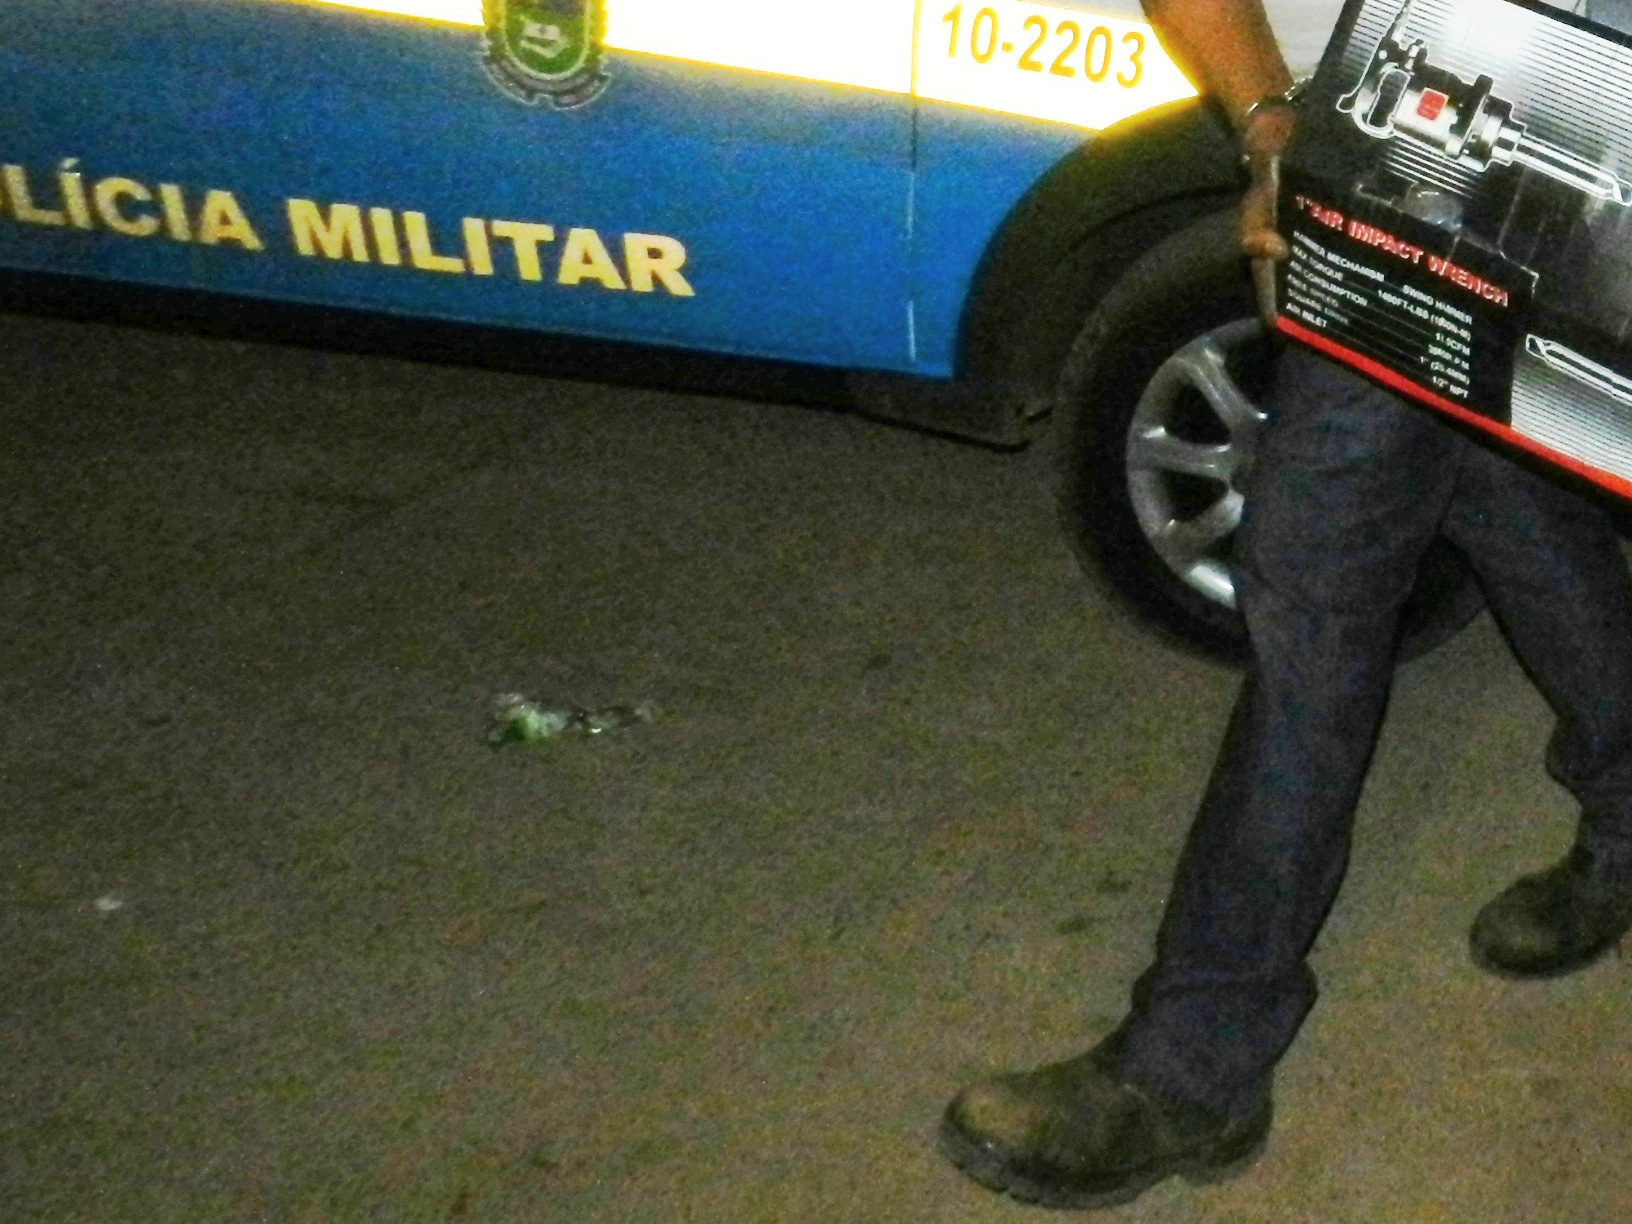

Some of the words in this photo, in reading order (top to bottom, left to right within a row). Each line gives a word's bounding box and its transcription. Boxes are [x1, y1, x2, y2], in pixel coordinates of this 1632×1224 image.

[941, 1, 1146, 89] 10-2203
[0, 156, 265, 253] LÍCIA
[286, 197, 694, 298] MILITAR
[1326, 251, 1385, 283] MECHANISM
[1347, 220, 1423, 264] IMPACT
[1427, 254, 1509, 308] WRENCH
[1303, 268, 1368, 307] CONSUMPTION
